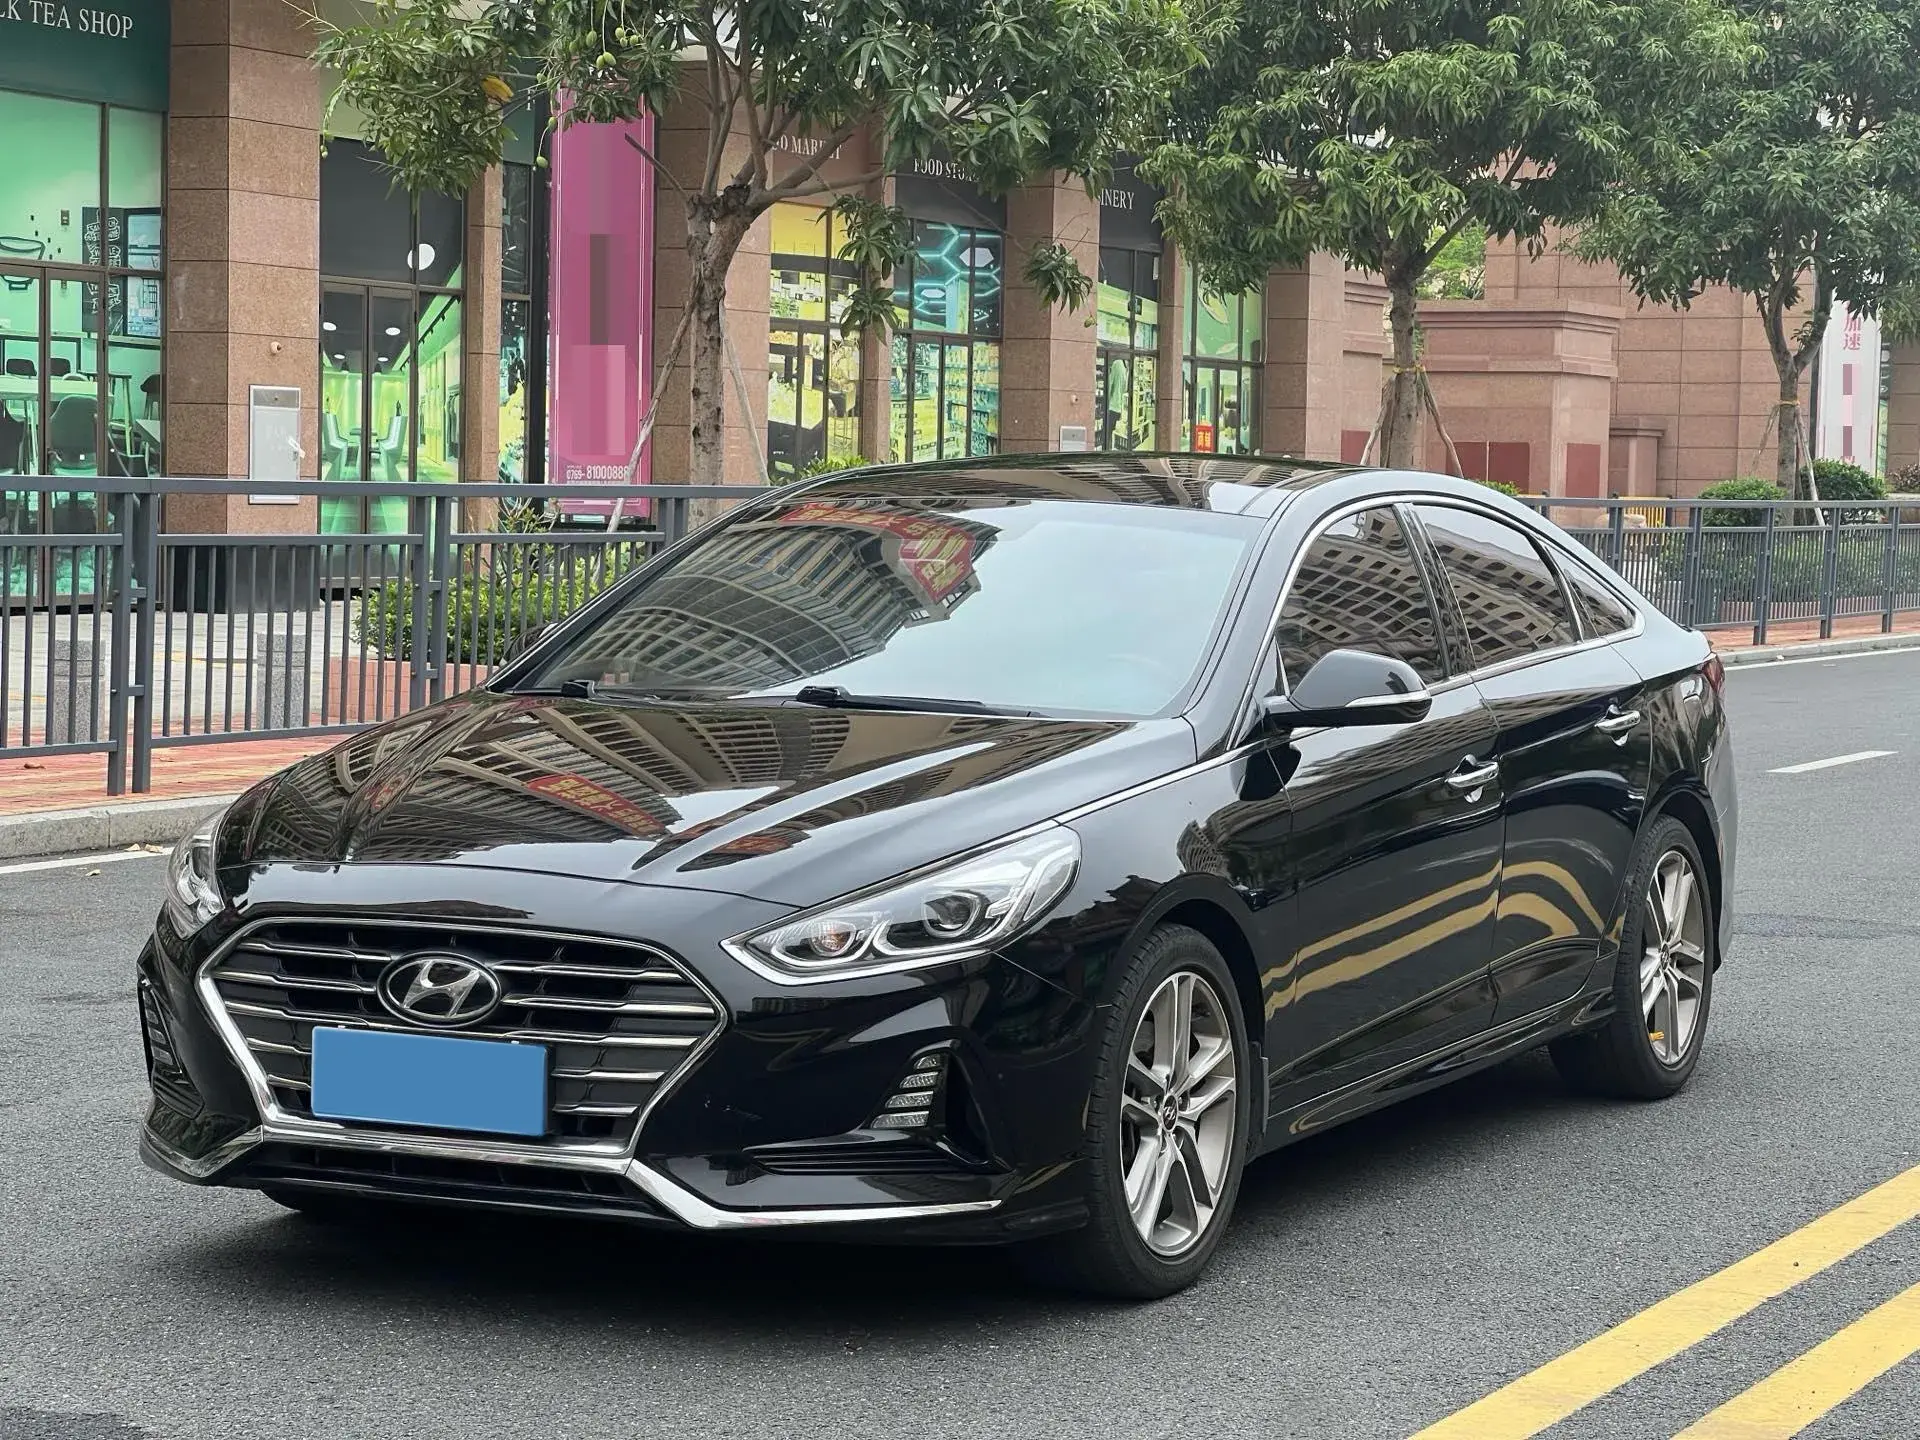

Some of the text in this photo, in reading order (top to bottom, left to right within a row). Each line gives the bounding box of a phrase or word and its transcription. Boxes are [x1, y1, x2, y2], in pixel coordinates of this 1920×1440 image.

[0, 0, 133, 38] K TEA SHOP
[791, 135, 842, 159] MART
